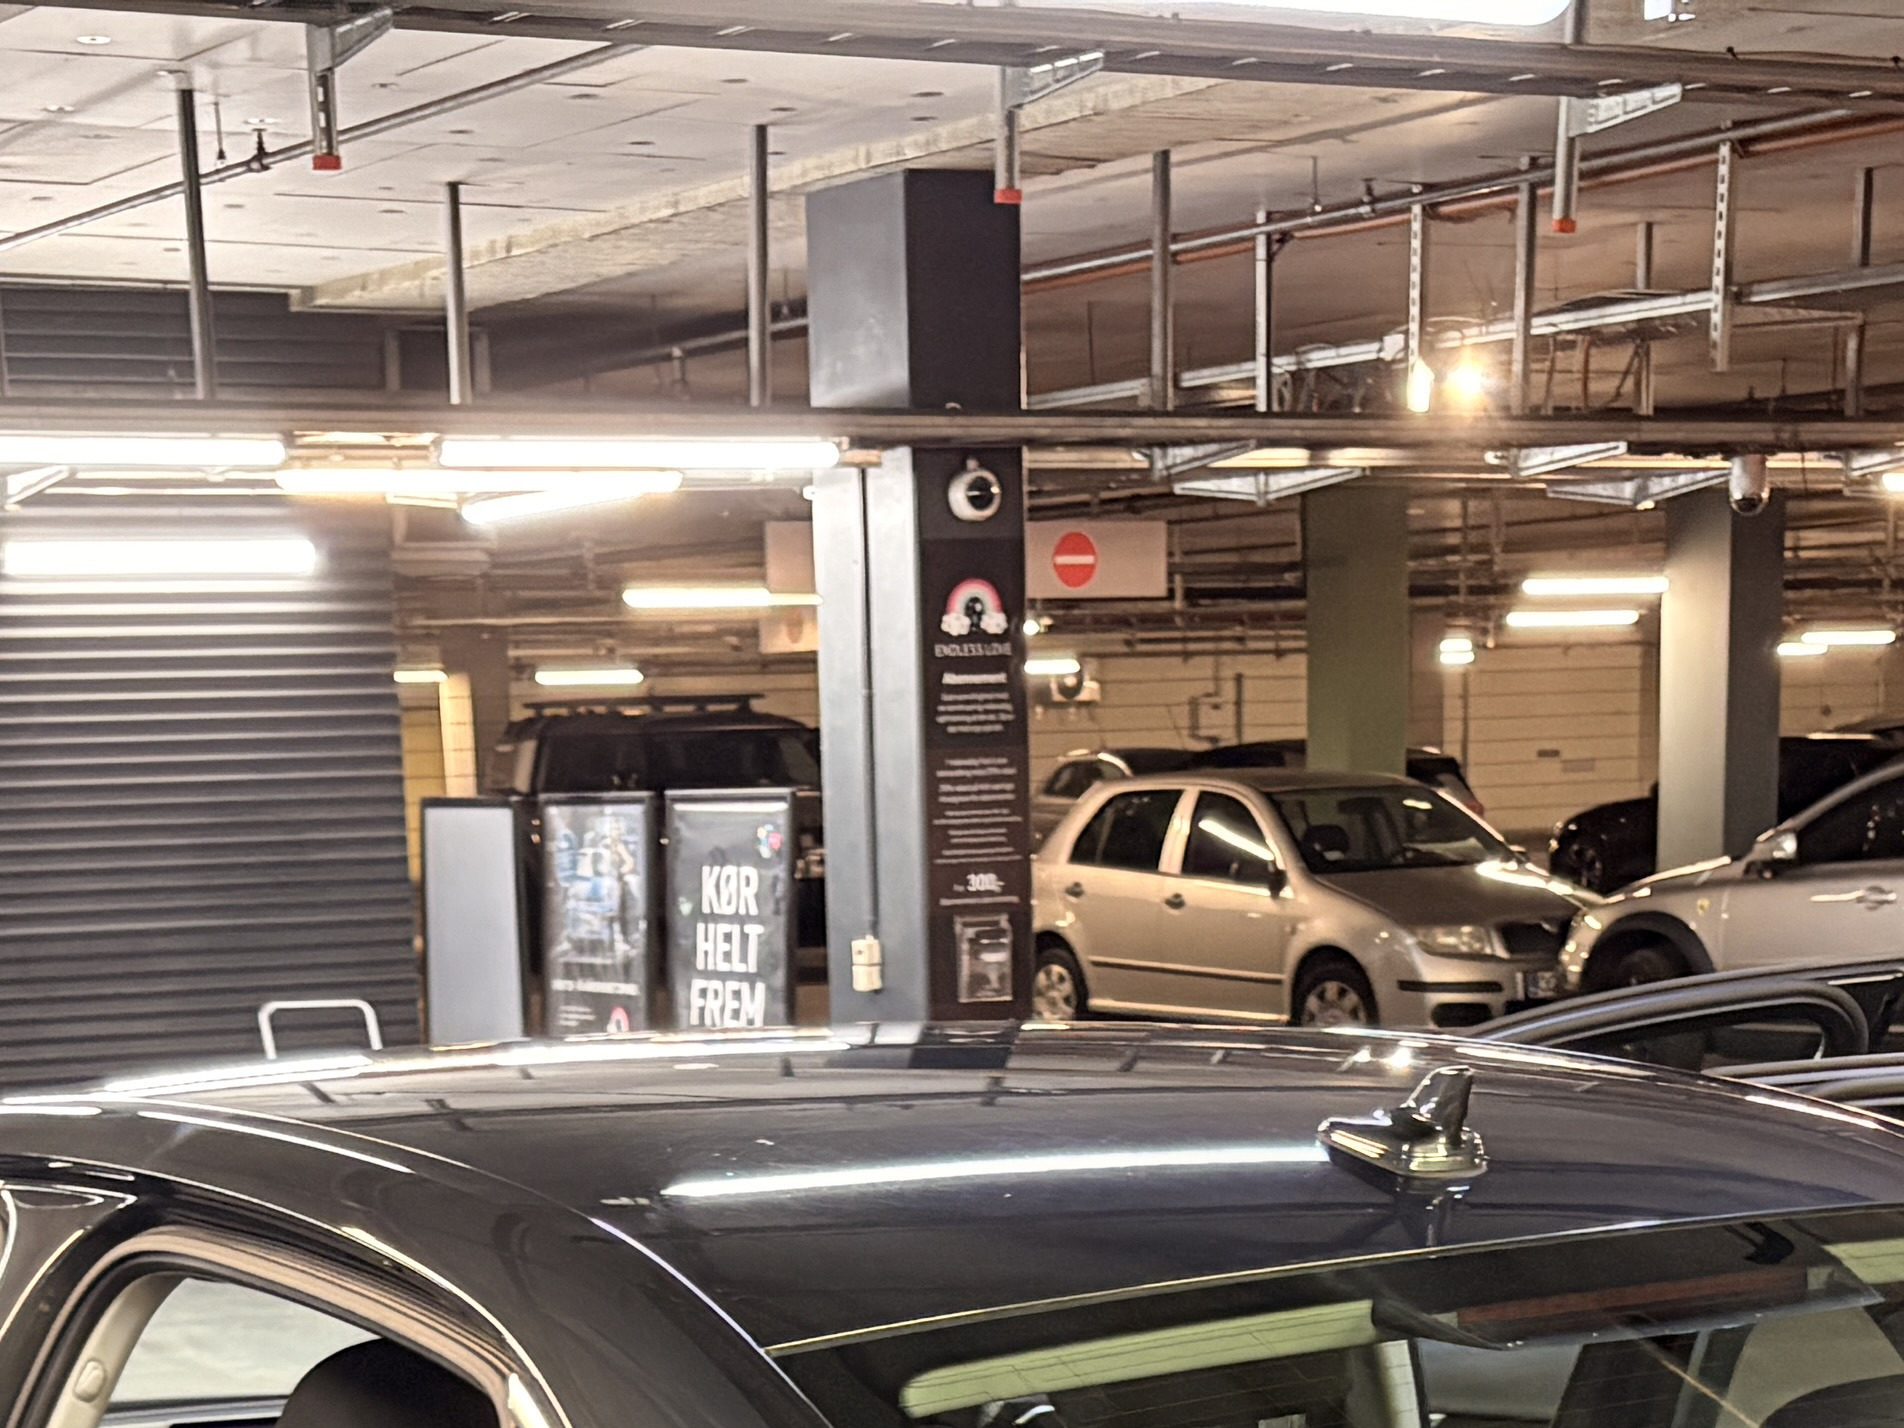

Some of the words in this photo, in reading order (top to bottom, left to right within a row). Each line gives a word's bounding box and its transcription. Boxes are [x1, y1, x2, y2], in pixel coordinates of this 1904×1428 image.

[701, 865, 759, 916] KØR
[696, 922, 765, 973] HELT
[689, 978, 766, 1028] FREM
